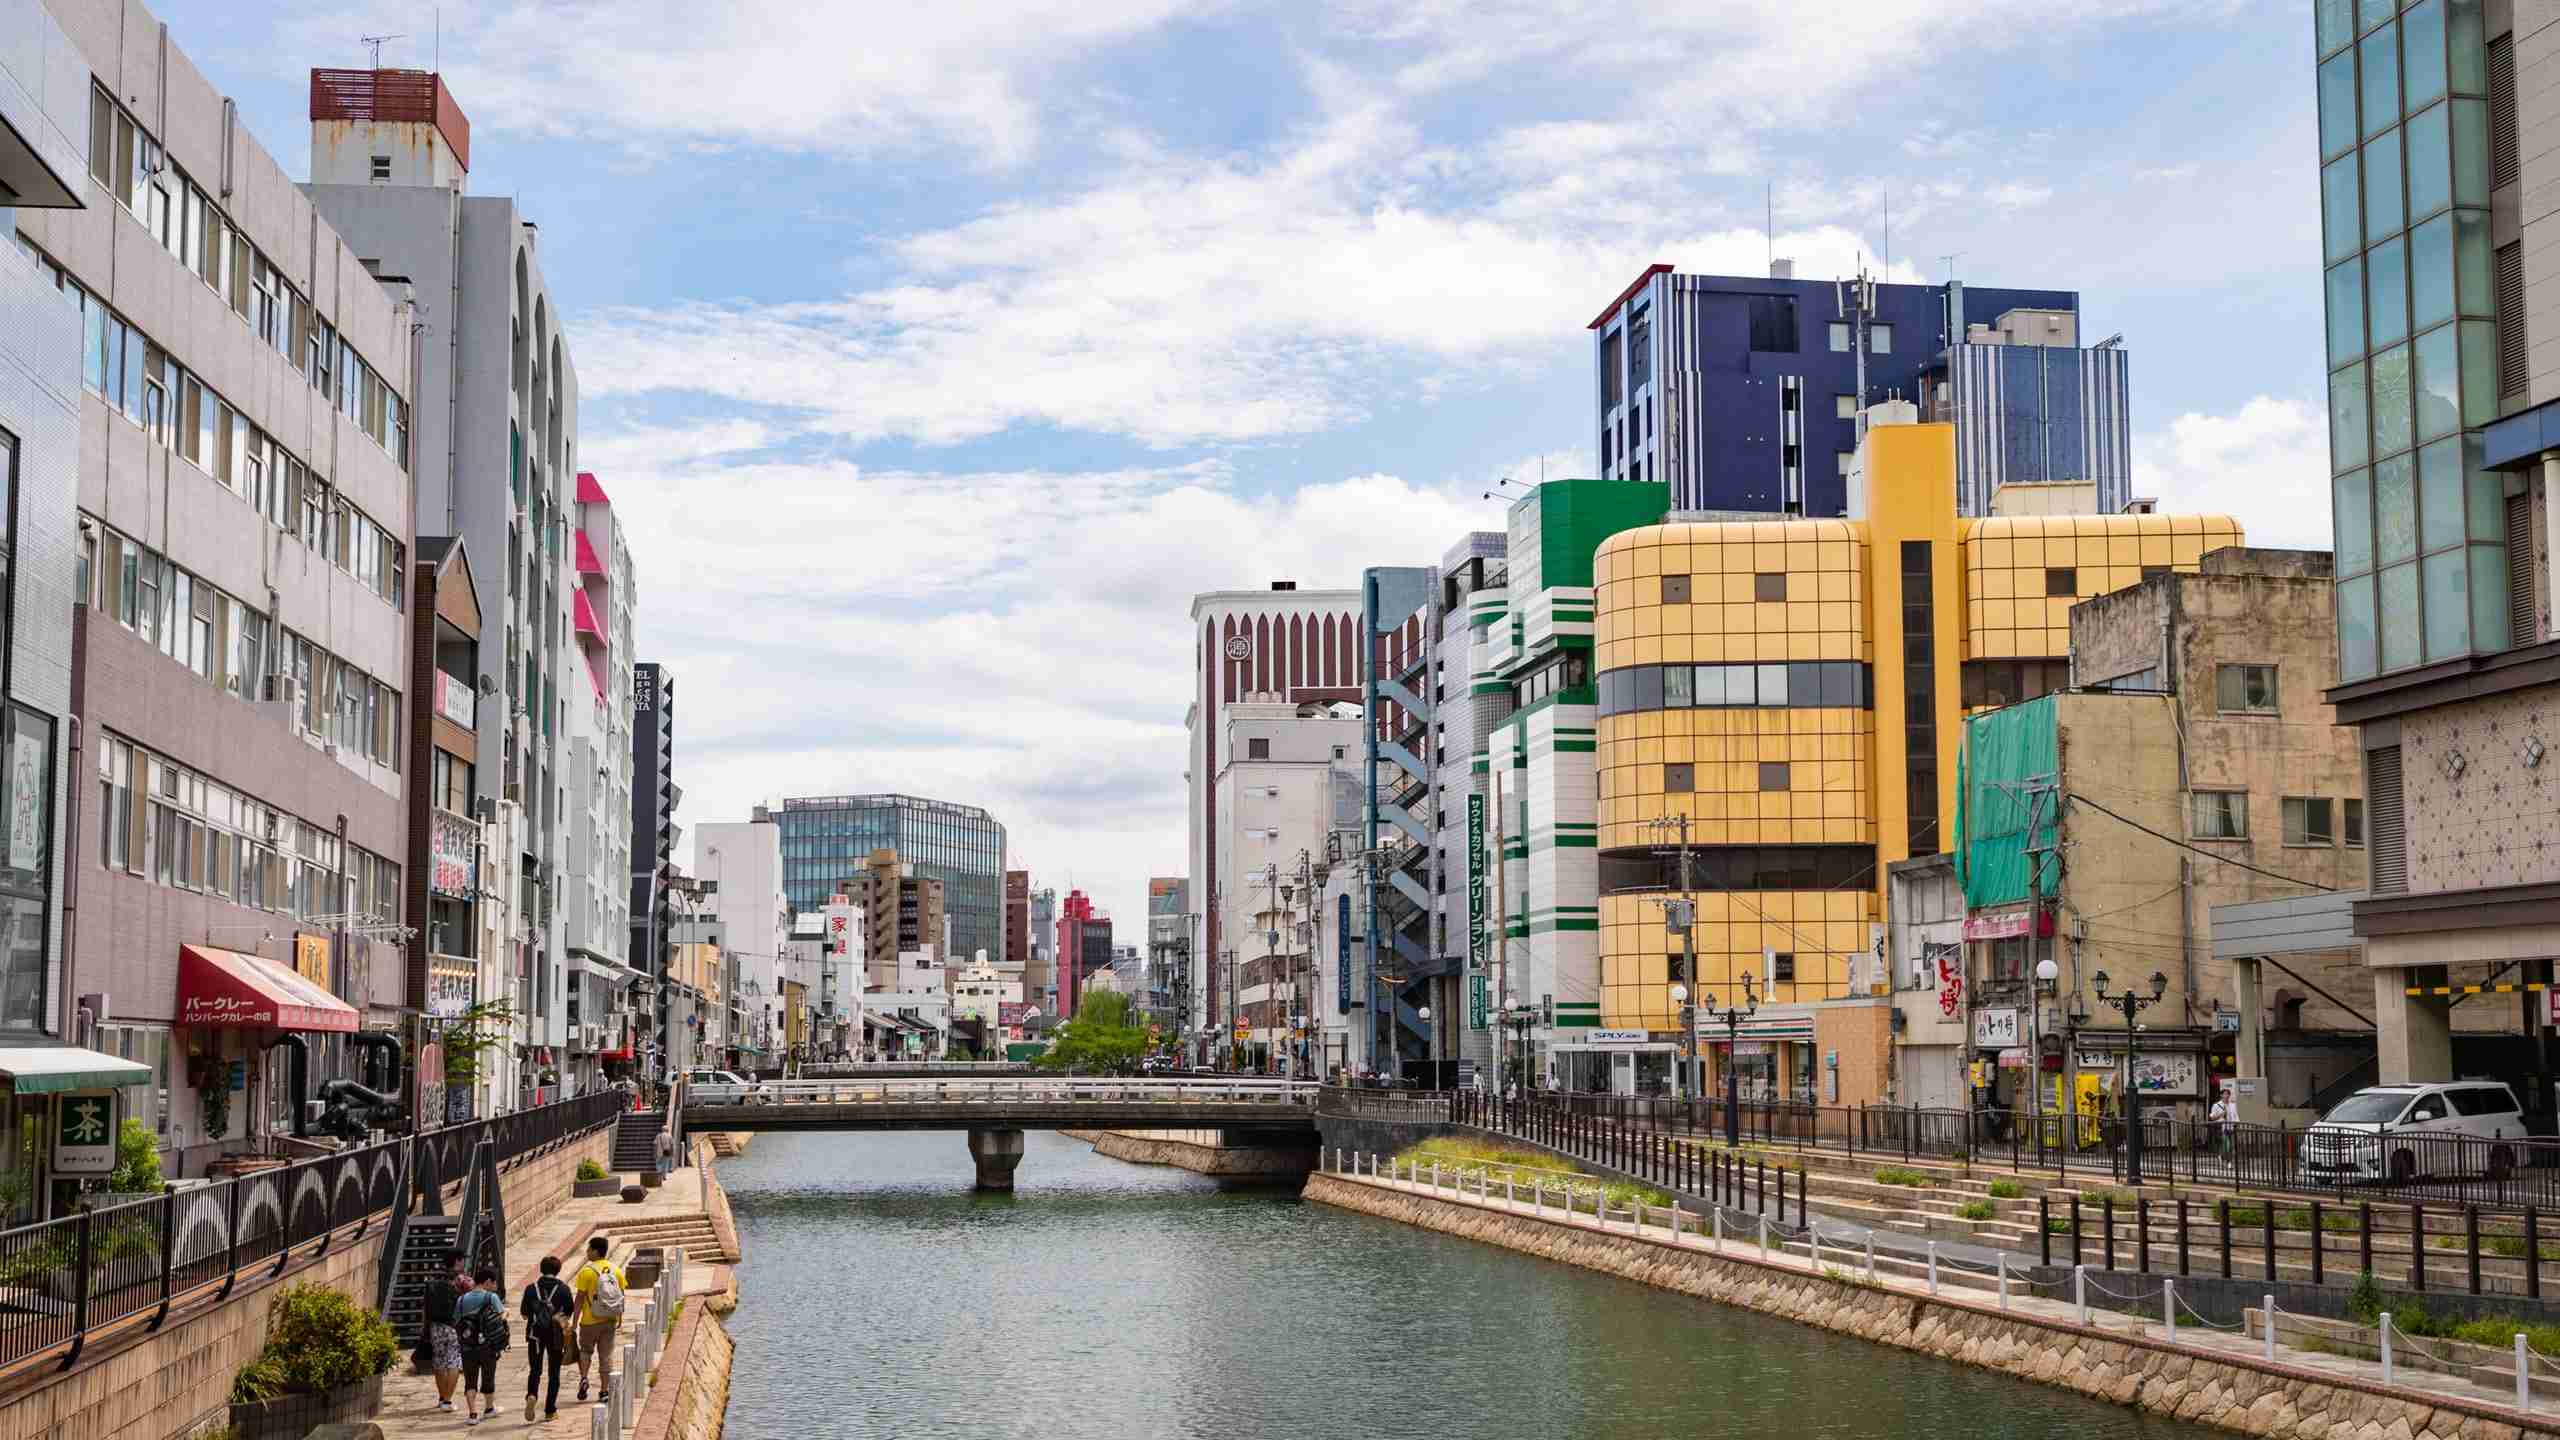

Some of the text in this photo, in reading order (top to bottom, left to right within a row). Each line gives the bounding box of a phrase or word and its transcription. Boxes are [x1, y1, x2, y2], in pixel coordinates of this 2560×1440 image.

[1471, 874, 1483, 963] グリーンランド
[63, 1098, 105, 1142] 茶
